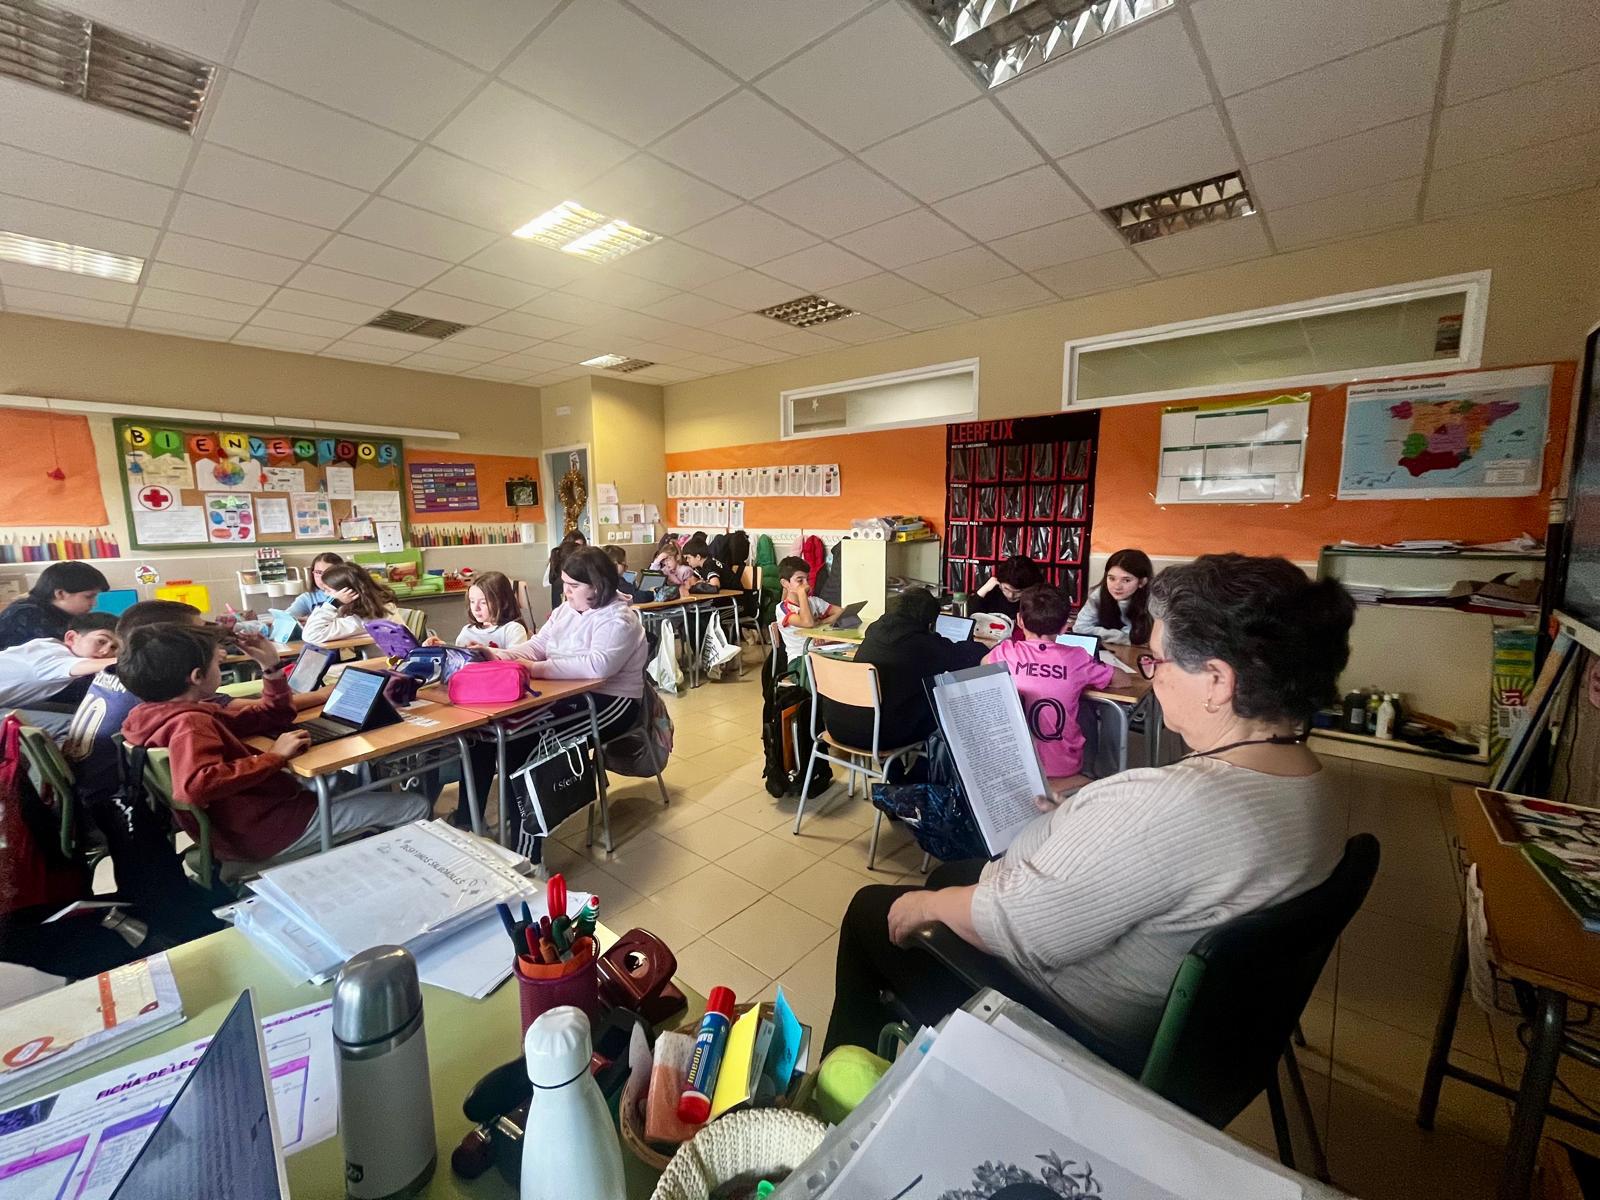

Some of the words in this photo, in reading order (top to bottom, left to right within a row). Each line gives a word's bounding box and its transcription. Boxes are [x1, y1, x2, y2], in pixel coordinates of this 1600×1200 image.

[131, 428, 393, 458] BIENVENIDOS
[952, 420, 1013, 442] LEERFLIX
[1015, 661, 1067, 680] MESSI
[68, 693, 107, 761] 10
[96, 1077, 141, 1100] FICHA
[147, 1067, 168, 1081] DE
[172, 1057, 199, 1072] LEC
